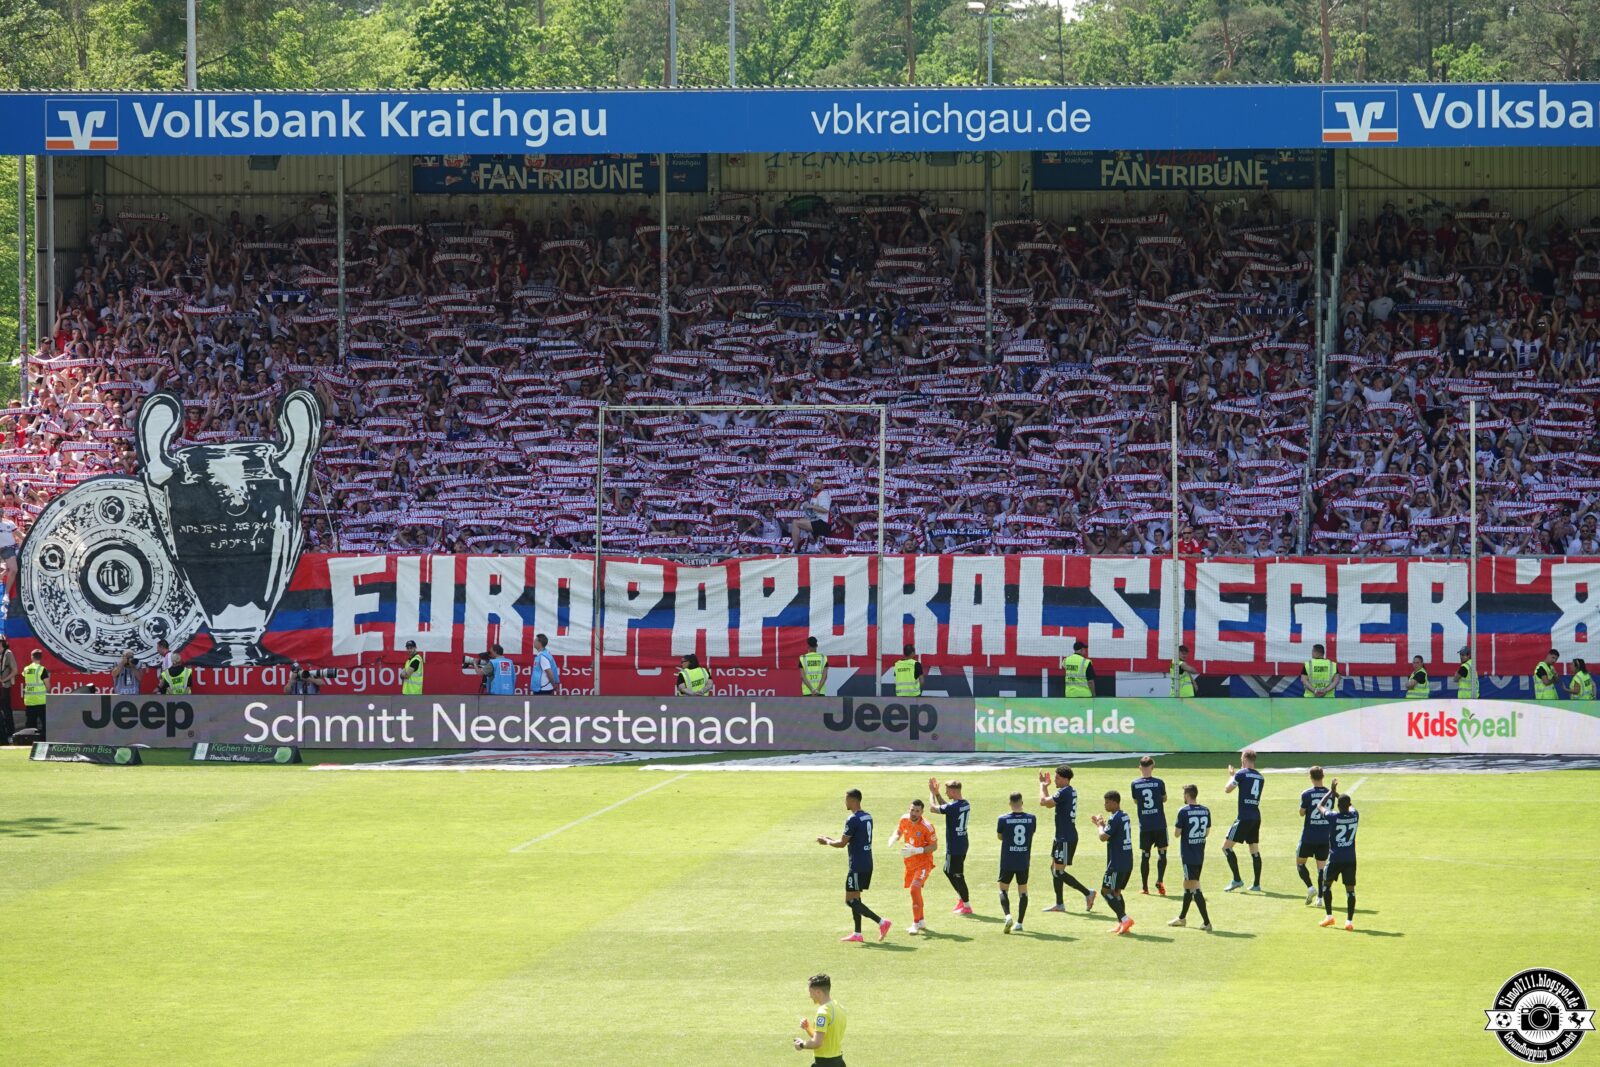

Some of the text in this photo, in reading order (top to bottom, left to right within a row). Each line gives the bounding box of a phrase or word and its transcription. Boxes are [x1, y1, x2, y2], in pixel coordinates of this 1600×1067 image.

[811, 101, 1091, 142] vbkraichgau.de
[1413, 89, 1594, 129] Volksba
[132, 98, 607, 147] Volksbank Kraichgau
[478, 160, 644, 190] FAN-TRIBÜNE
[1100, 157, 1269, 187] FAN-TRIBÜNE
[214, 665, 250, 687] für
[82, 696, 194, 738] Jeep
[243, 700, 774, 744] Schmitt Neckarsteinach
[823, 697, 938, 740] Jeep
[974, 708, 1135, 734] kidsmeal.de
[211, 743, 272, 753] Küchen mit Biss
[1142, 789, 1154, 809] 3
[1251, 779, 1260, 800] 4
[1014, 825, 1026, 846] 8
[1189, 816, 1208, 839] 23
[1336, 823, 1358, 844] 27
[848, 876, 854, 889] 9
